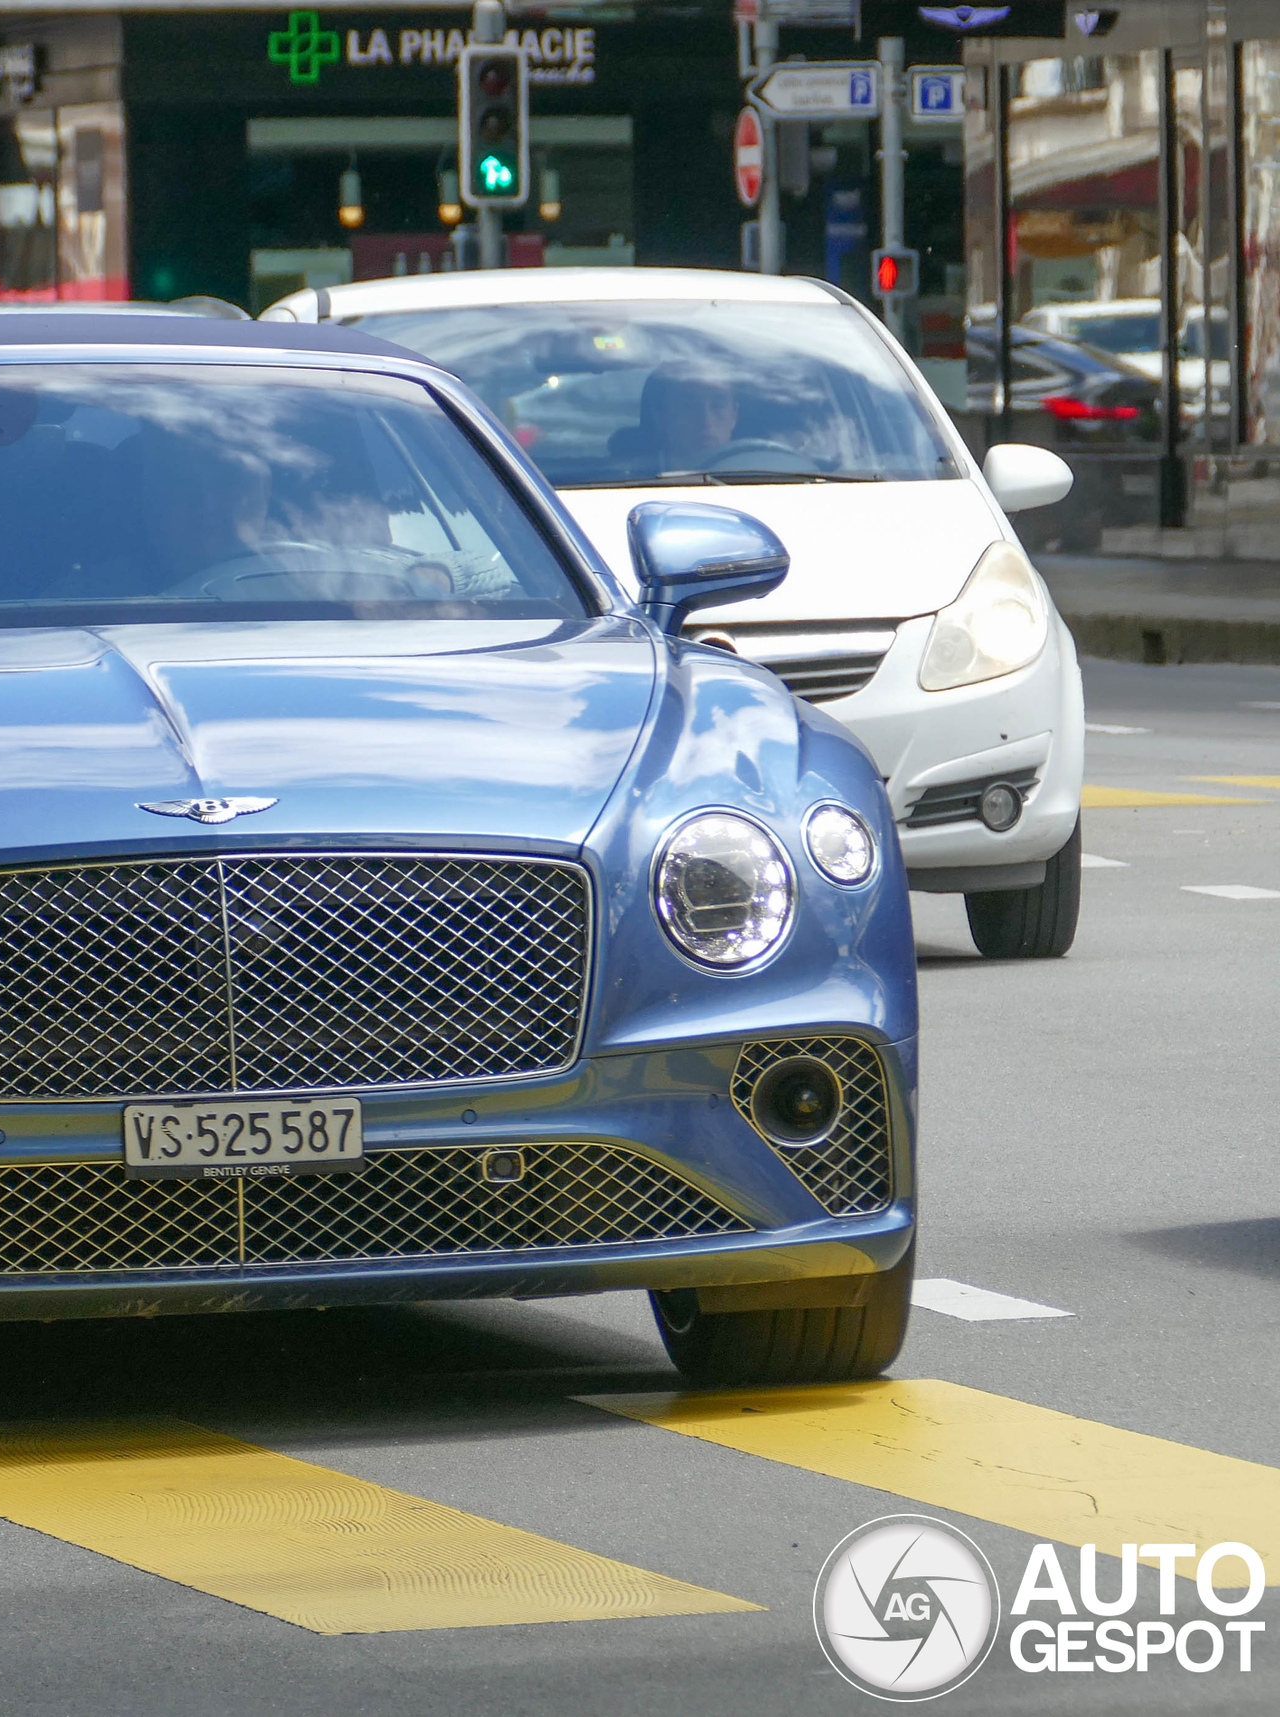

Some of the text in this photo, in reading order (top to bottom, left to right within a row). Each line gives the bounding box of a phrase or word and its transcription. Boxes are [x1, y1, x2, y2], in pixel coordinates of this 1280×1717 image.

[347, 28, 596, 64] LA PHAACIE
[203, 1166, 248, 1177] BENTLEY
